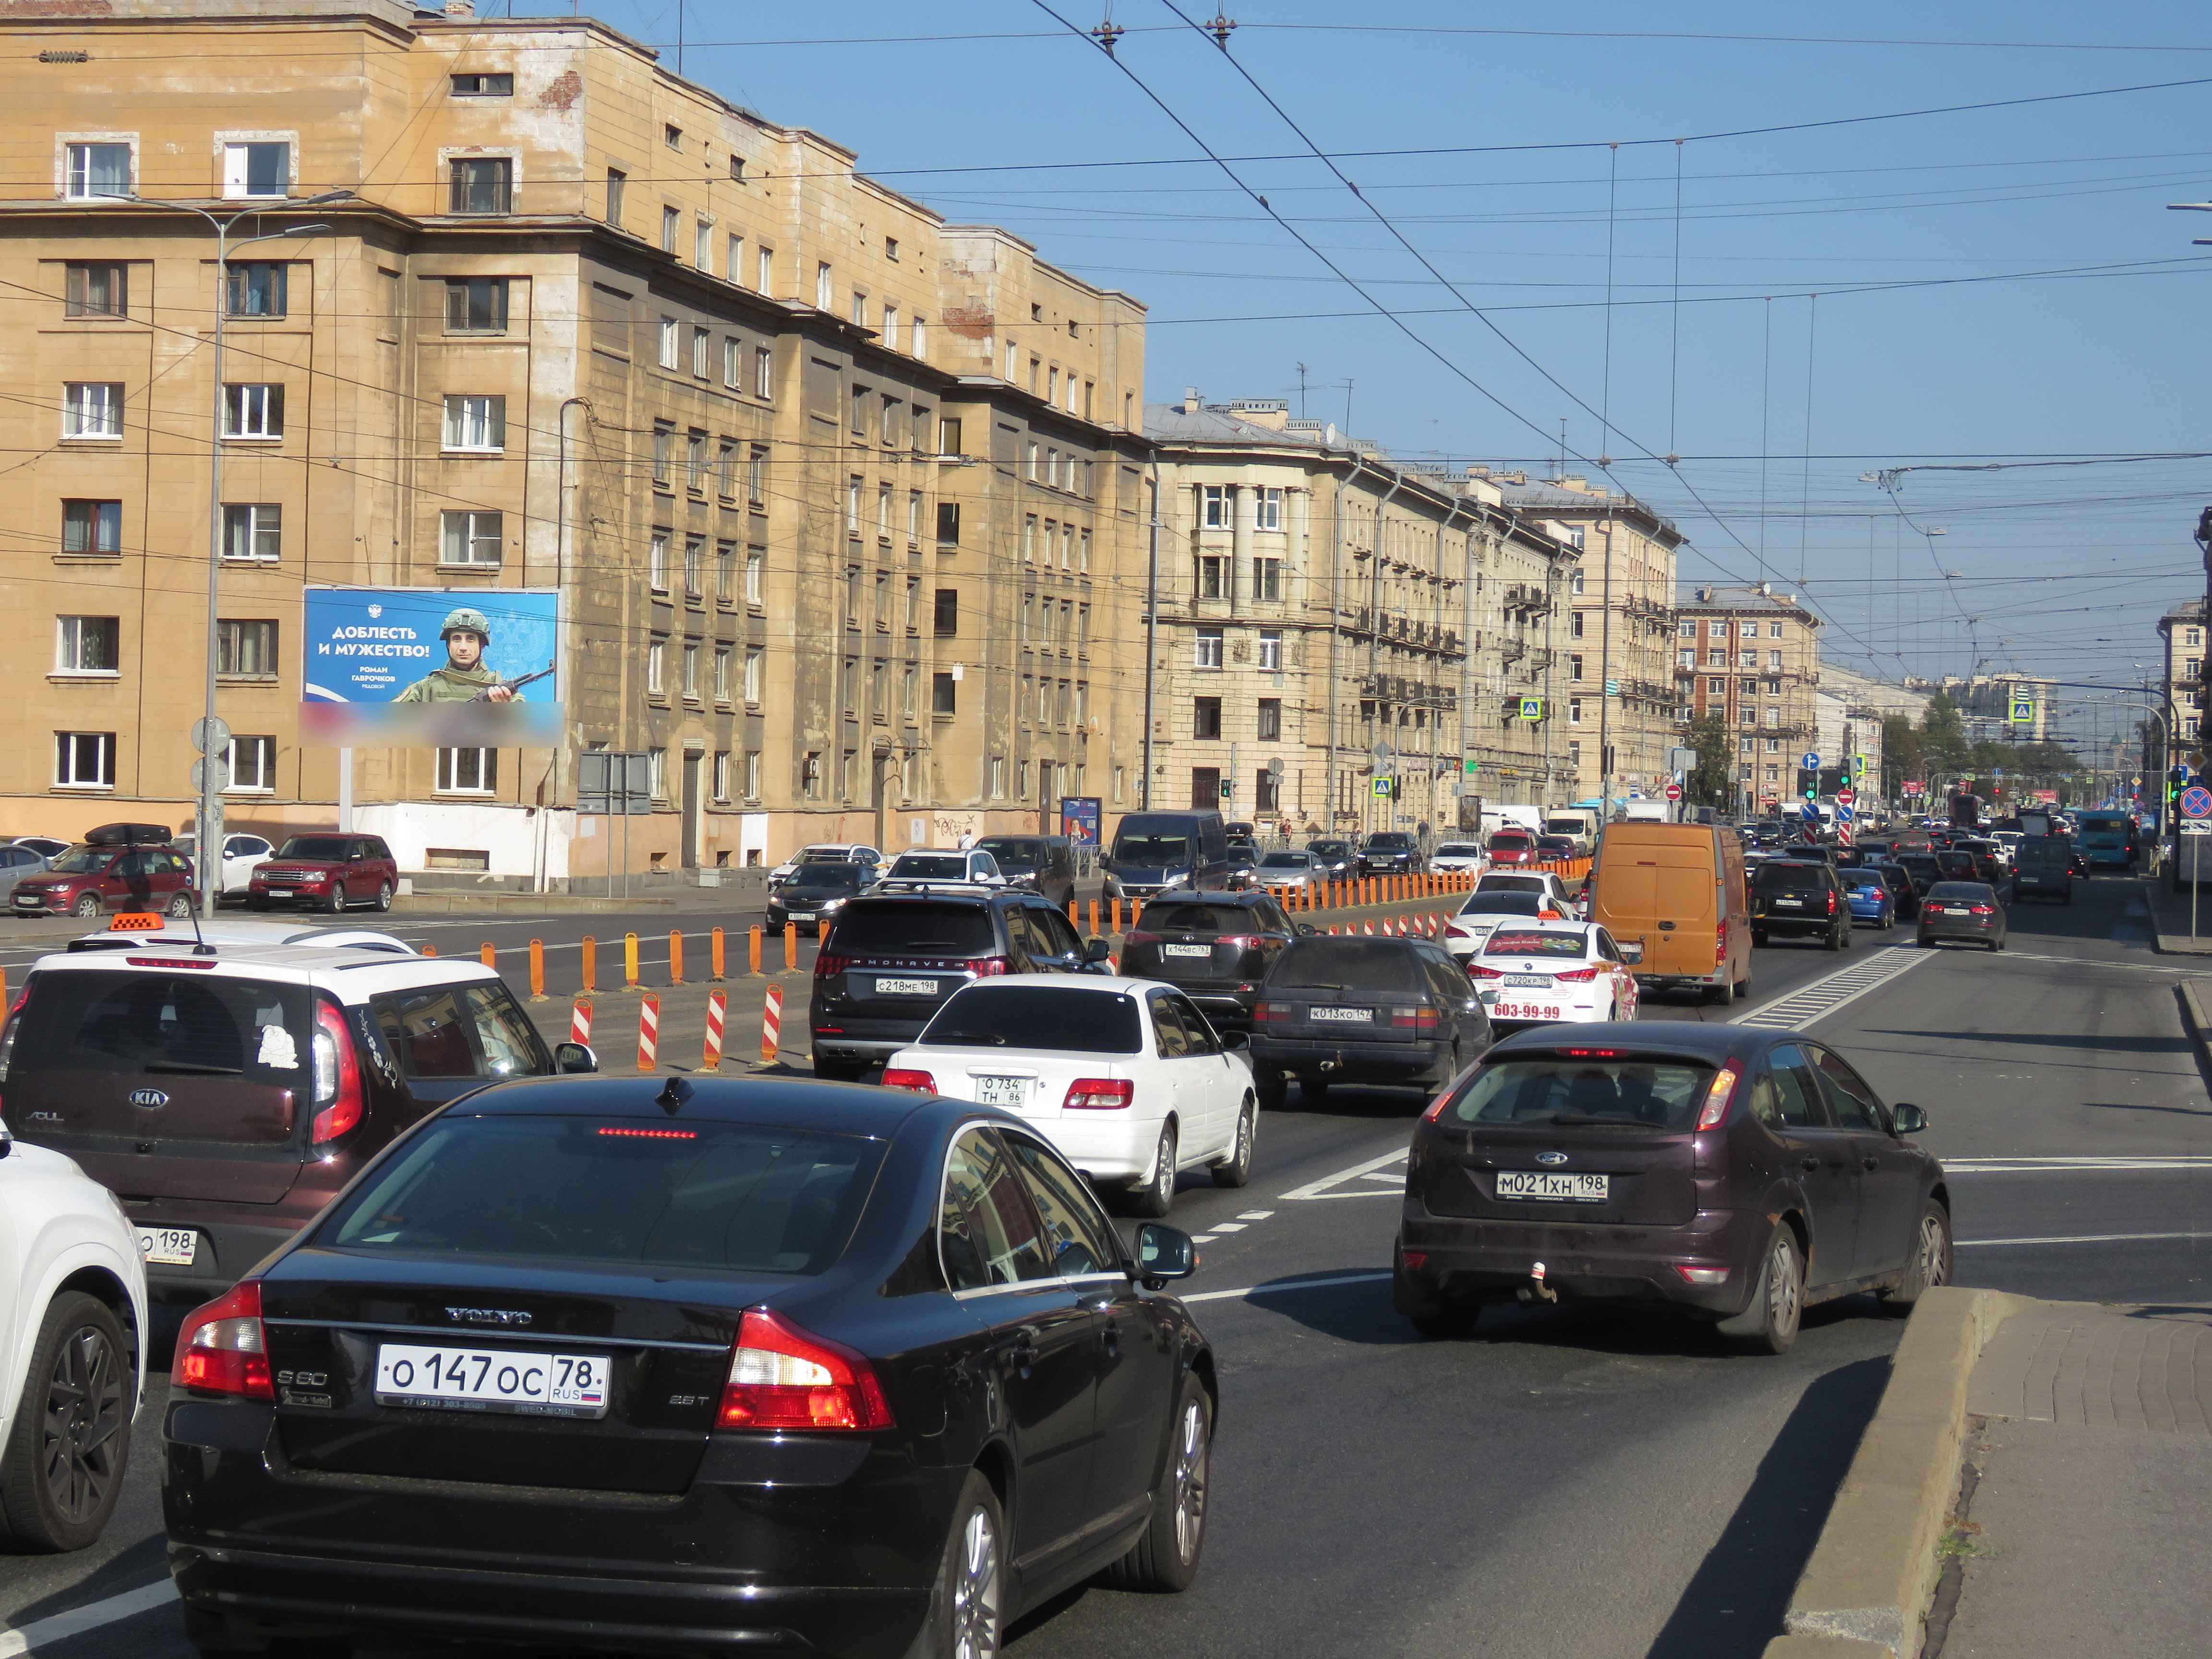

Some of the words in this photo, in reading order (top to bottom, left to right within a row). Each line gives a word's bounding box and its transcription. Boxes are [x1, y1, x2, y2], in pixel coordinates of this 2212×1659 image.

[332, 626, 417, 639] ДОБЛЕСТЬ
[318, 643, 330, 655] И
[335, 644, 430, 657] МУЖЕСТВО!
[879, 981, 917, 992] С218МЕ
[920, 981, 935, 989] 198
[1507, 976, 1537, 985] С720КР
[1313, 1009, 1352, 1019] К013КО
[1355, 1009, 1370, 1017] 147
[1494, 1003, 1560, 1019] 603-99-99
[998, 1079, 1018, 1090] 734
[135, 1092, 160, 1105] KIA
[982, 1092, 998, 1103] ТН
[1009, 1093, 1020, 1101] 86
[1502, 1174, 1572, 1194] М021ХН
[1577, 1175, 1603, 1190] 198
[159, 1230, 190, 1249] 198
[445, 1307, 533, 1324] VOLVO
[392, 1353, 543, 1396] О147ОС
[556, 1358, 593, 1389] 78
[553, 1388, 580, 1400] RUS
[514, 1405, 577, 1417] SWED-MOBIL
